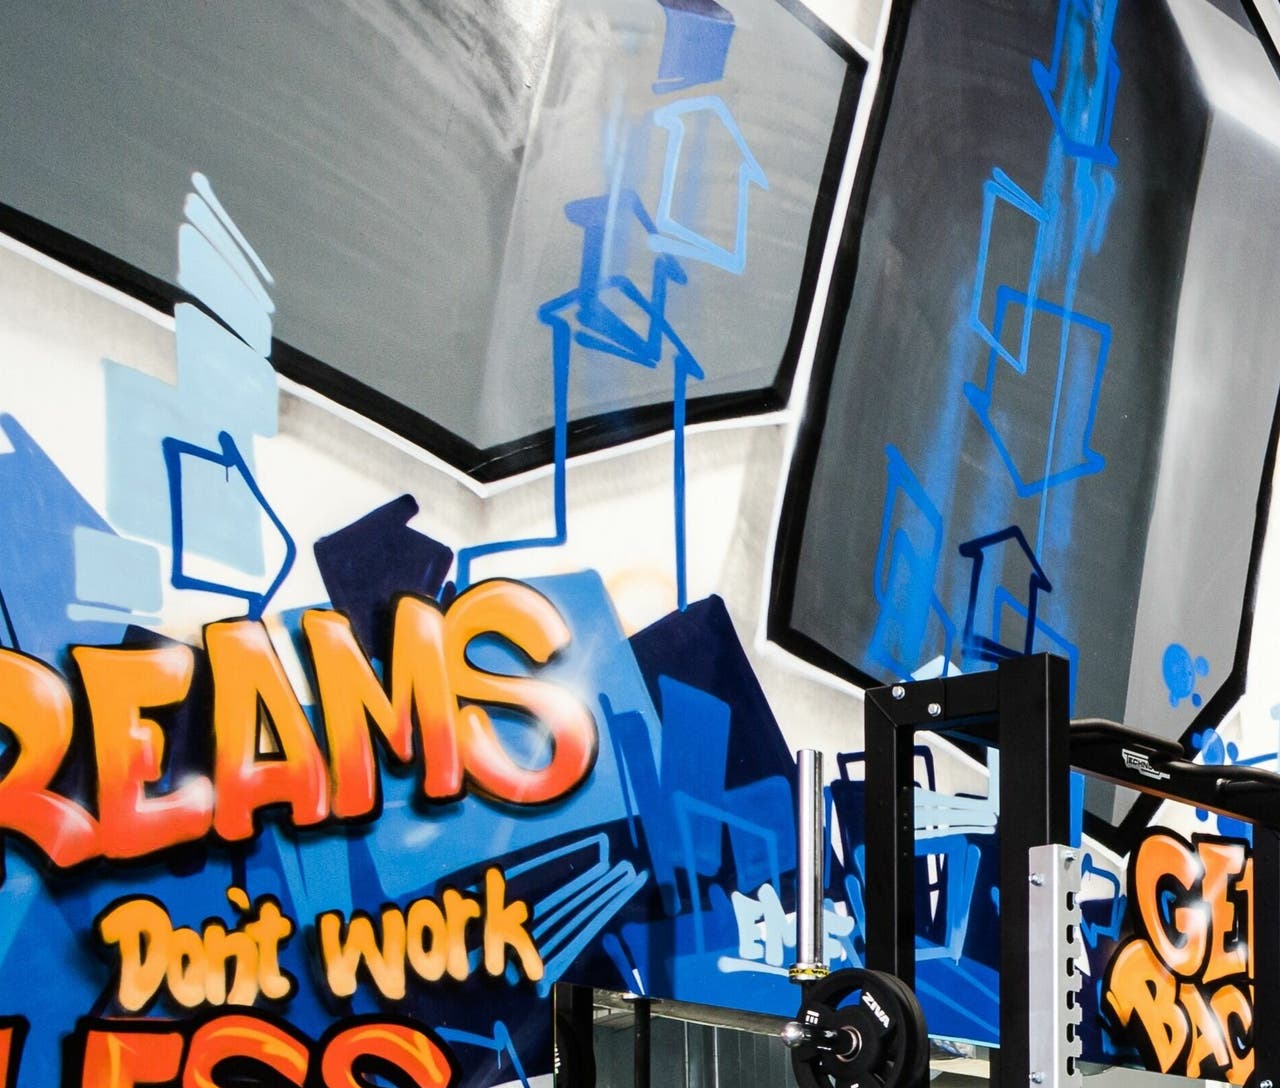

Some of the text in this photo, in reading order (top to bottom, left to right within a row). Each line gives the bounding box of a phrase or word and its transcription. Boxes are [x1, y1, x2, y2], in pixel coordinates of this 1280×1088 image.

[319, 867, 546, 1000] work
[861, 991, 890, 1029] ZIVA
[1106, 938, 1256, 1087] BAC
